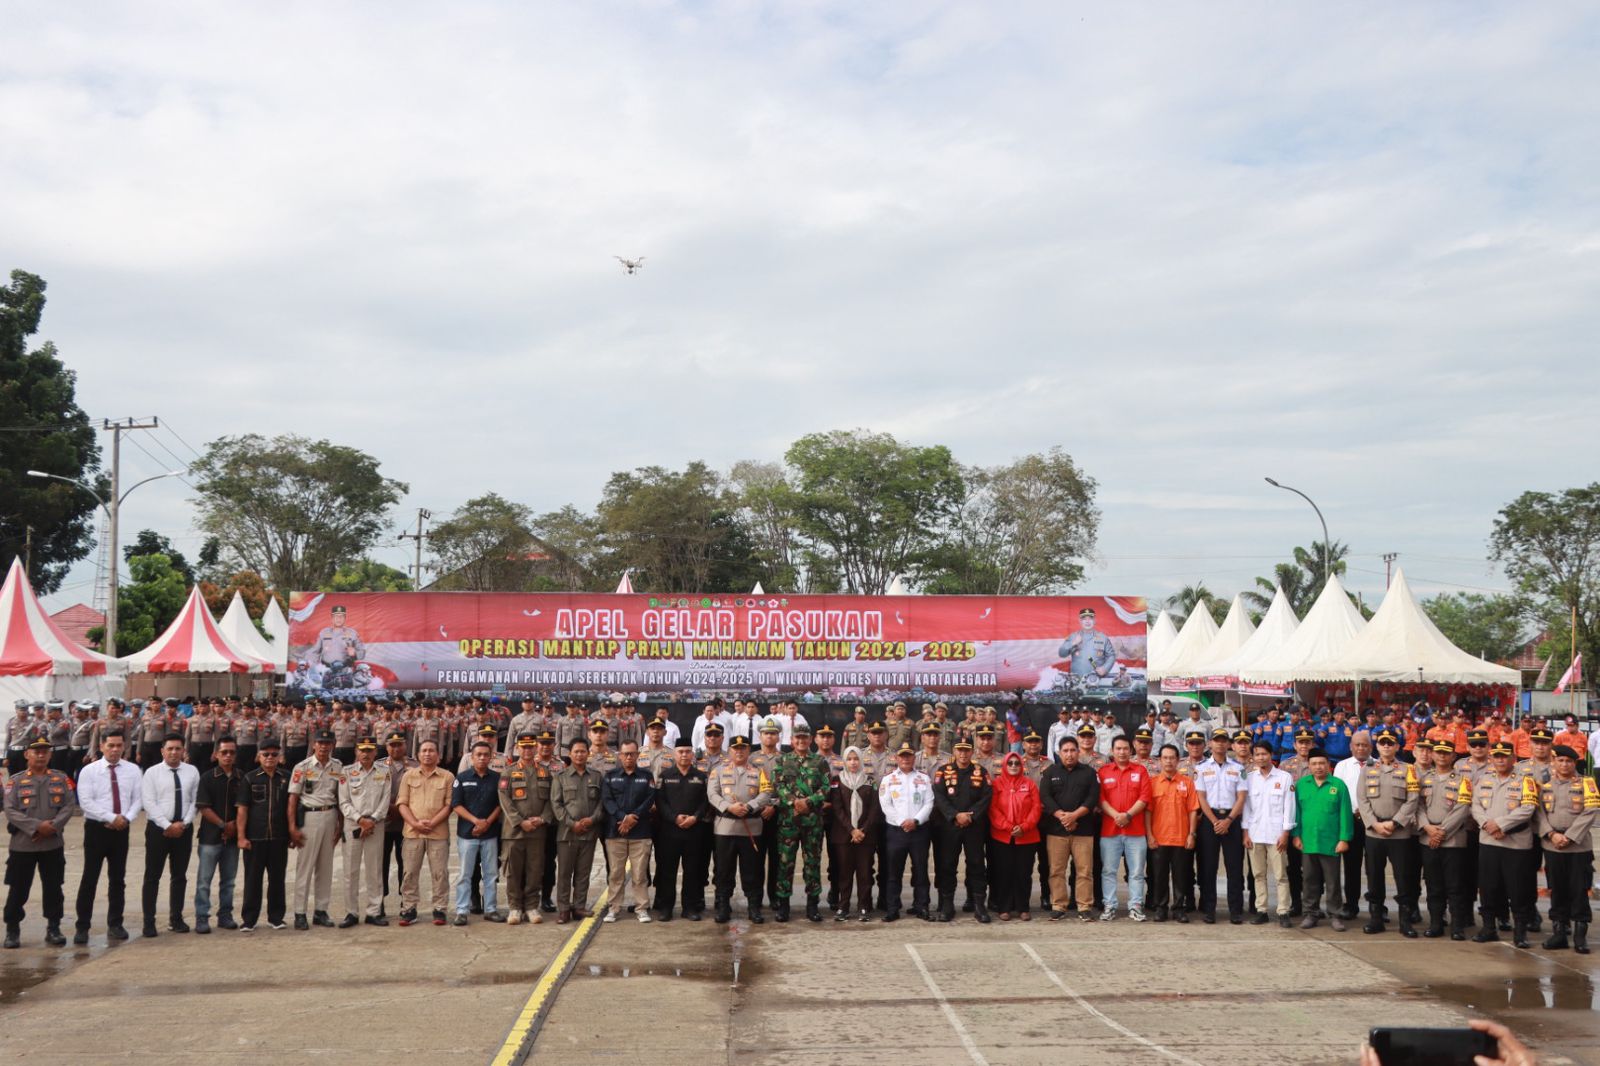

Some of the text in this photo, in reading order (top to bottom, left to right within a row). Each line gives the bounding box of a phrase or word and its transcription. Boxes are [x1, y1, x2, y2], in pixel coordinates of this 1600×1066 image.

[554, 609, 883, 641] APEL GELAR PASUKAN
[459, 639, 538, 658] OPERASI
[543, 640, 620, 659] MANTAP
[626, 640, 686, 659] PRAJA
[692, 640, 786, 660] MAHAKAM
[792, 641, 852, 660] TAHUN
[857, 642, 906, 661] 2024
[924, 642, 976, 661] 2025
[438, 670, 997, 686] PENGAMANAN PILKADA SERENTAK TAHUN 2024-2025 DI WILKUM POLRES KUTAI KARTANEGARA
